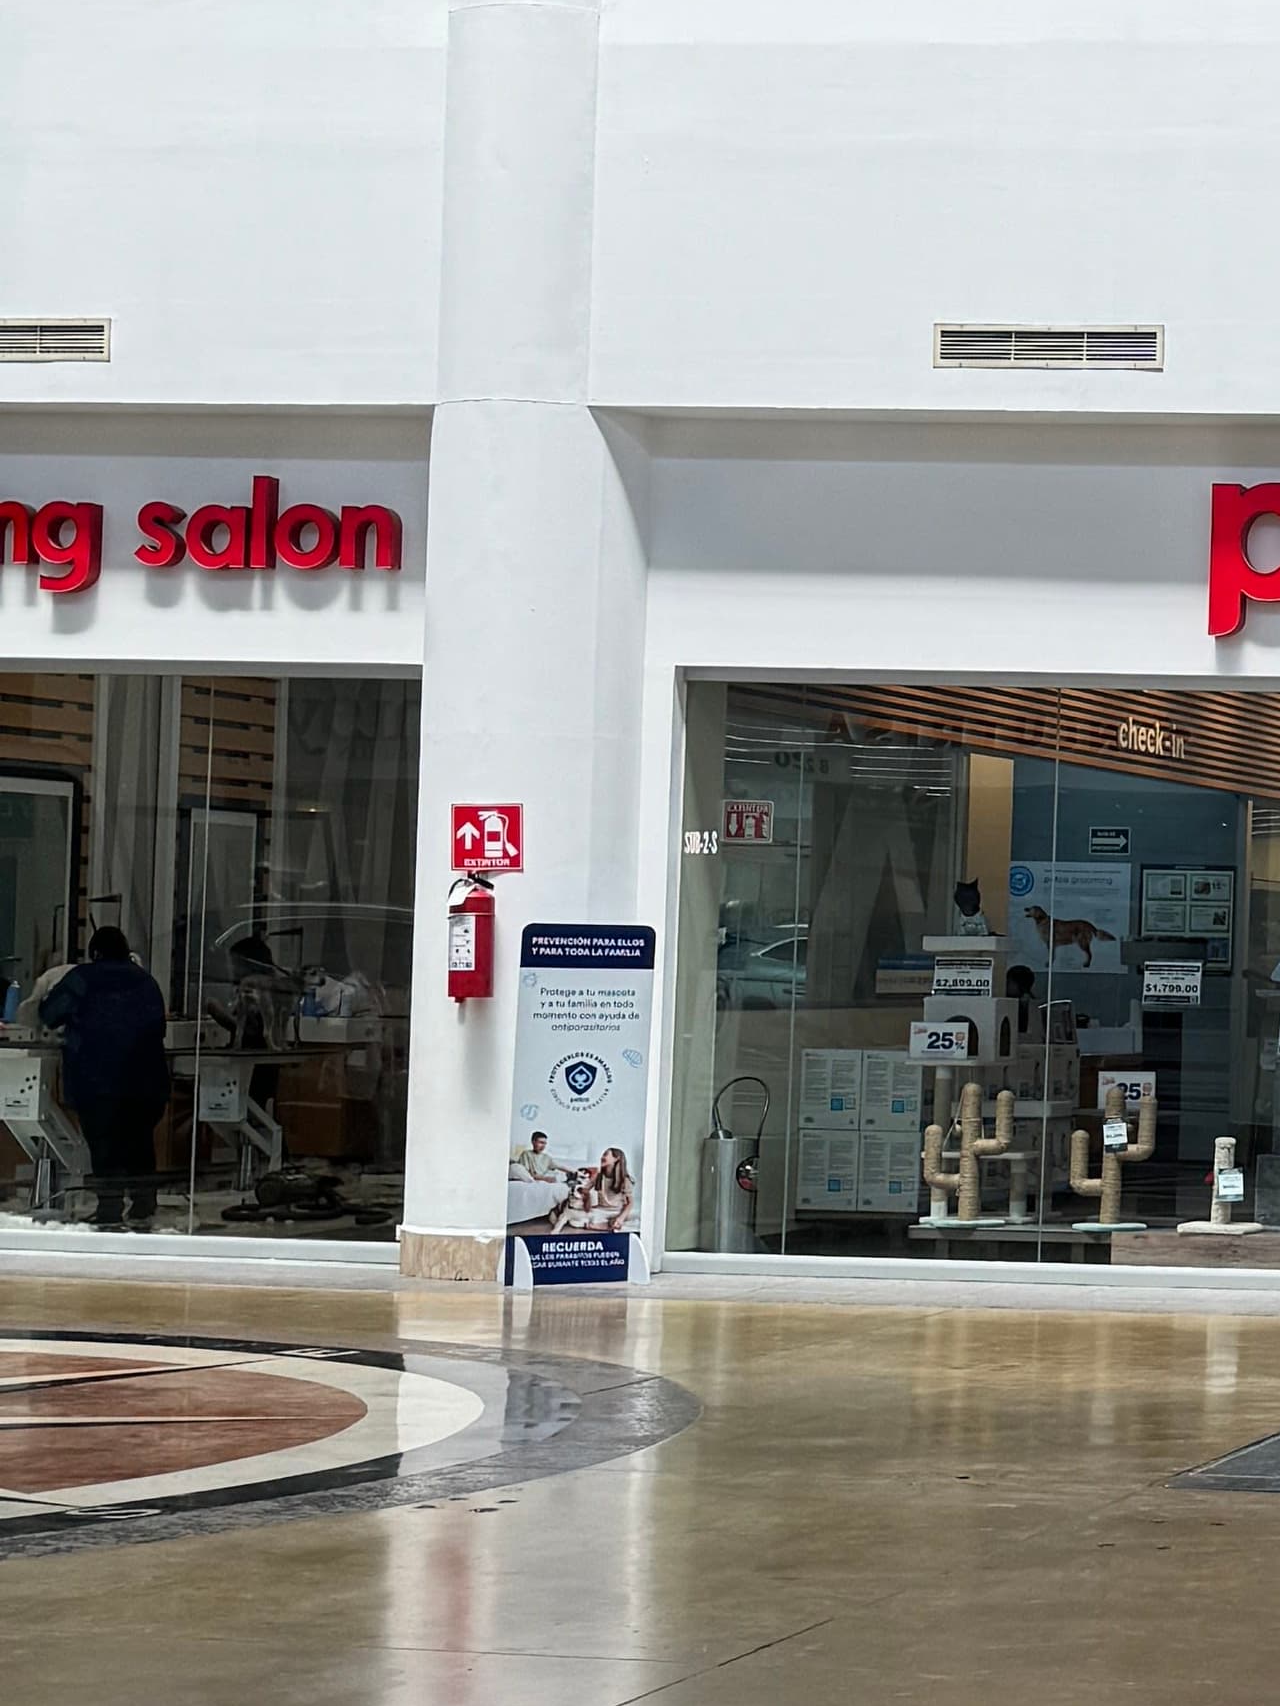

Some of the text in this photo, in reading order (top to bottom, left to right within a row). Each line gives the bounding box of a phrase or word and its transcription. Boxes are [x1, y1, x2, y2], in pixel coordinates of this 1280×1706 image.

[133, 475, 403, 570] salon
[1117, 715, 1188, 760] check-in
[463, 858, 511, 867] EXTINTOR
[542, 1241, 604, 1253] RECUERDA
